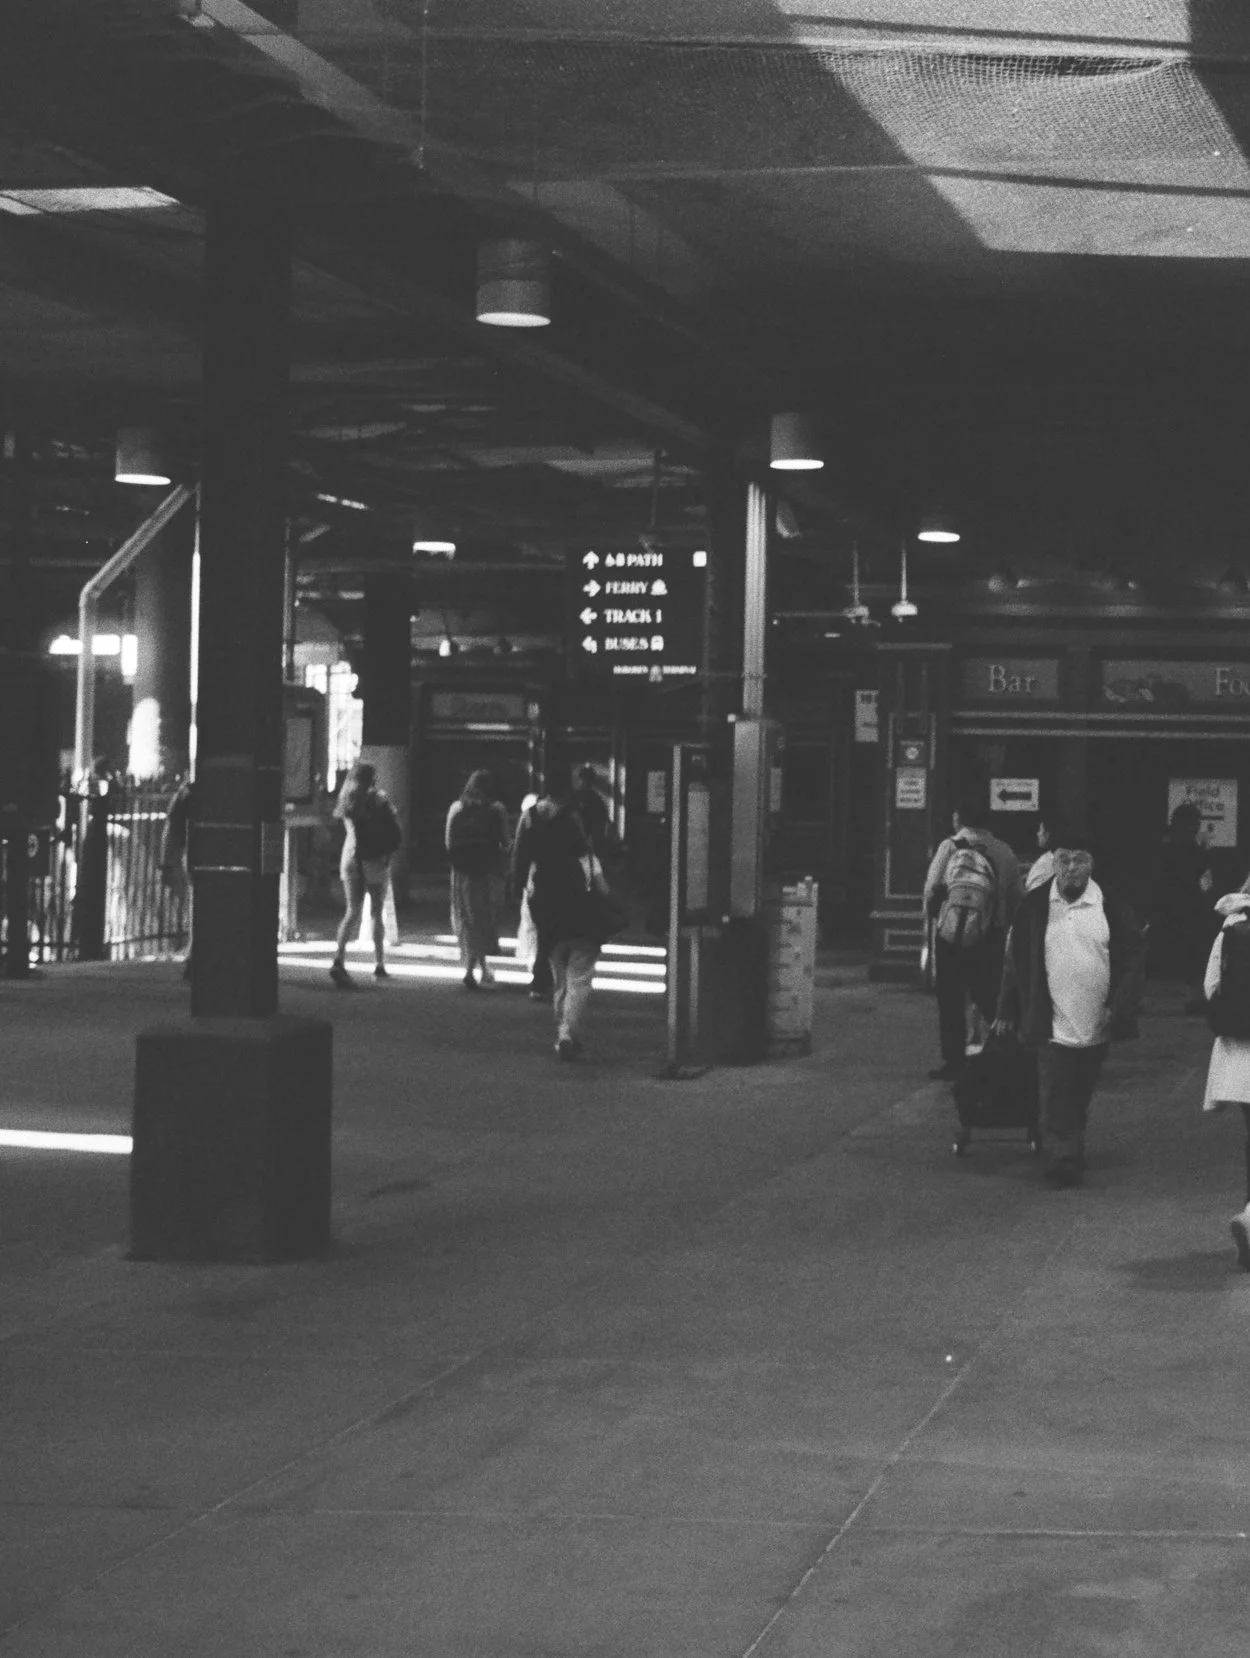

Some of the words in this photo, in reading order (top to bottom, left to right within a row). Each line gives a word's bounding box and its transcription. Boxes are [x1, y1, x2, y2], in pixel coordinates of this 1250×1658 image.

[626, 552, 663, 567] PATH
[605, 580, 648, 594] FERRY
[603, 608, 651, 623] TRACK
[988, 664, 1035, 693] Bar
